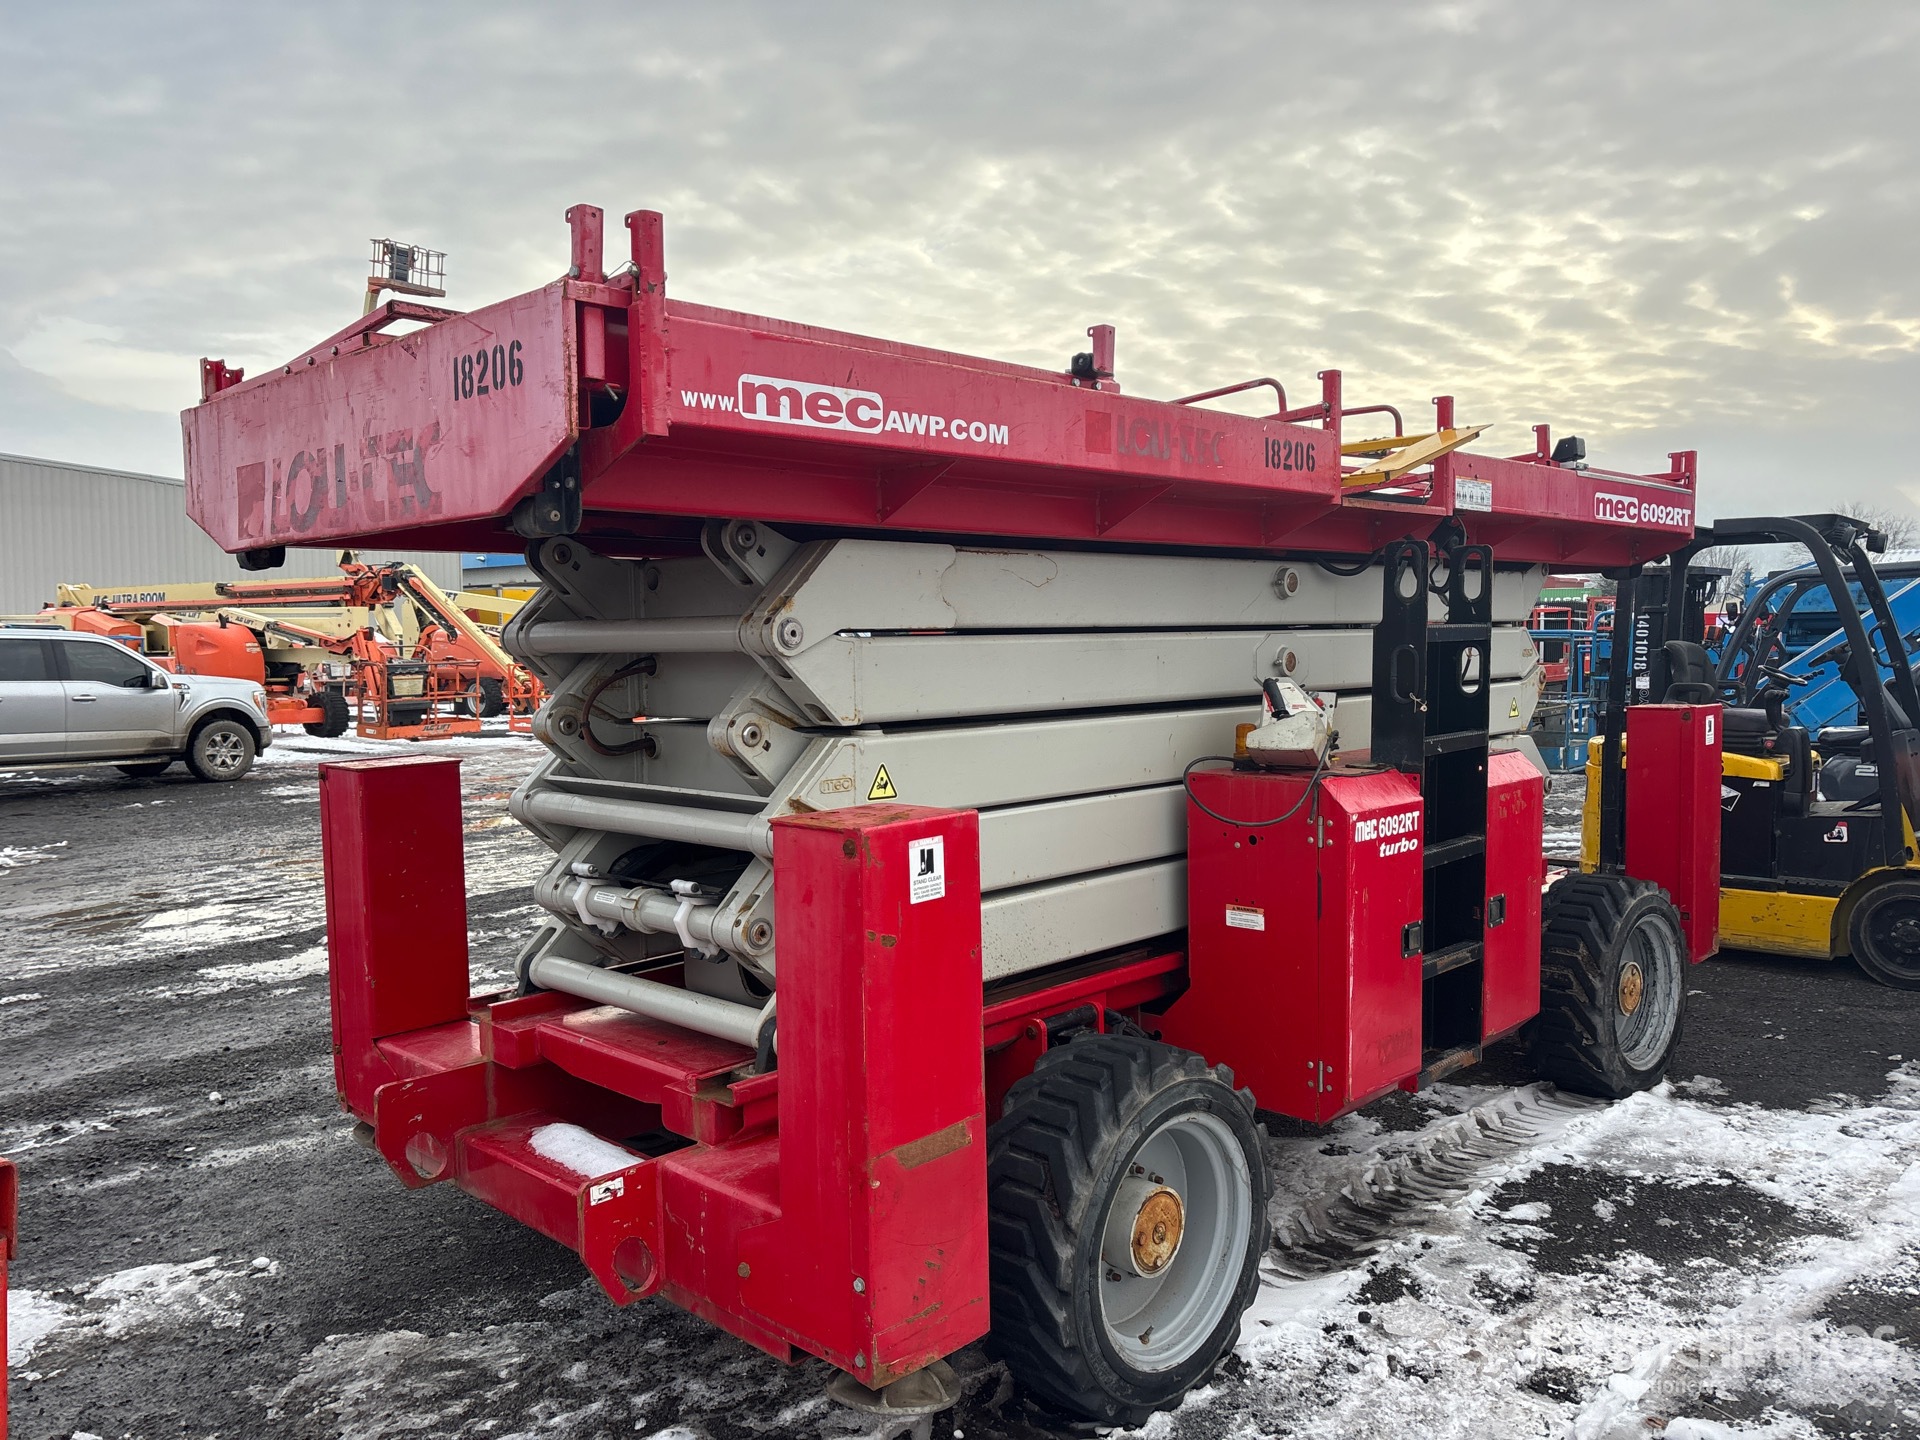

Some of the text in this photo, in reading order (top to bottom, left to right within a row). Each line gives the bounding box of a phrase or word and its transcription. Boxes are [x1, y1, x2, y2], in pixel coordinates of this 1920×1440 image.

[453, 339, 524, 401] 18206
[1264, 436, 1316, 473] 18206
[1595, 496, 1692, 527] mec 6092RT
[140, 592, 166, 603] BOOM
[1633, 613, 1651, 670] 1401018
[1378, 811, 1420, 838] 6092RT
[1379, 837, 1418, 858] turbo
